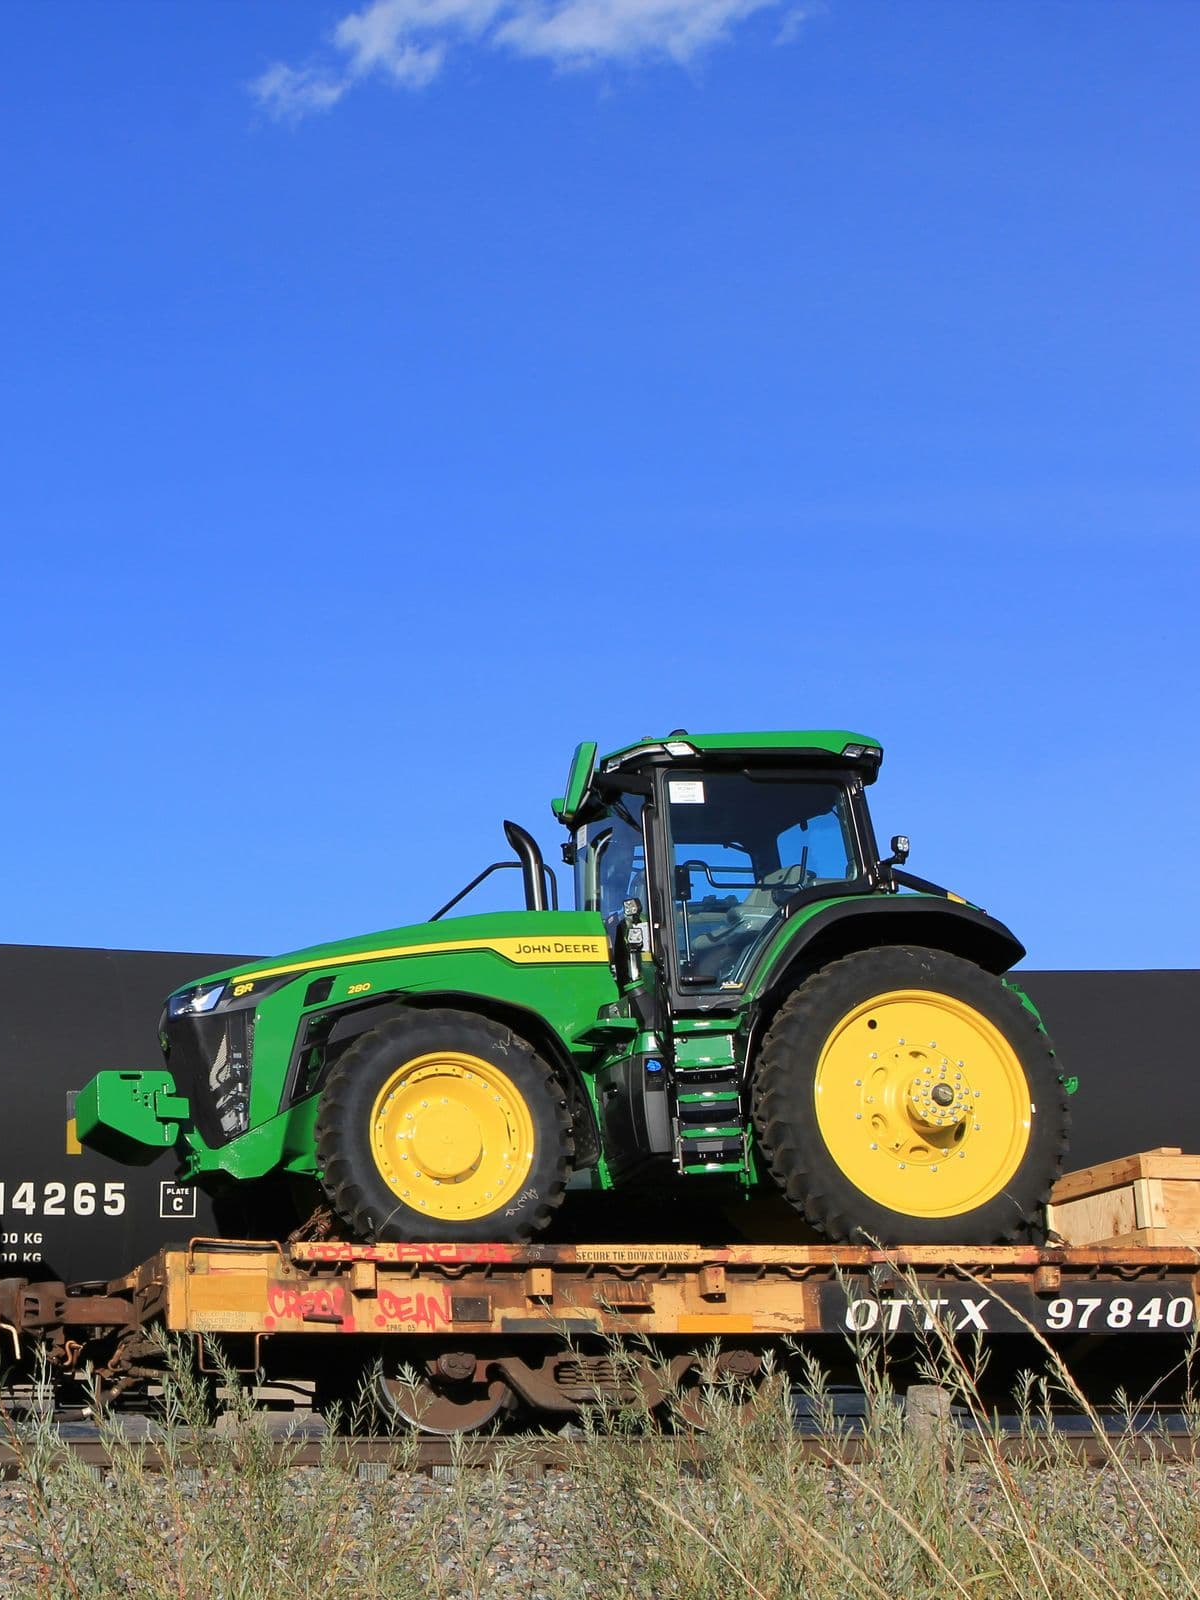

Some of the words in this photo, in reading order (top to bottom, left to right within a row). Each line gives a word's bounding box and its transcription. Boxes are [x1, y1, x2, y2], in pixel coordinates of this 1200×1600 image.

[515, 942, 551, 954] JOHN
[553, 942, 600, 954] DEERE
[233, 982, 255, 998] 8R
[347, 982, 371, 995] 280
[166, 1187, 190, 1196] PLATE
[173, 1198, 184, 1212] C
[23, 1232, 43, 1244] KG
[22, 1252, 42, 1263] KG
[576, 1250, 609, 1261] SECURE
[612, 1250, 626, 1261] TIE
[627, 1250, 654, 1261] DOWN
[656, 1250, 689, 1261] CHAINS
[846, 1298, 990, 1331] OTTX
[1046, 1297, 1194, 1330] 97840
